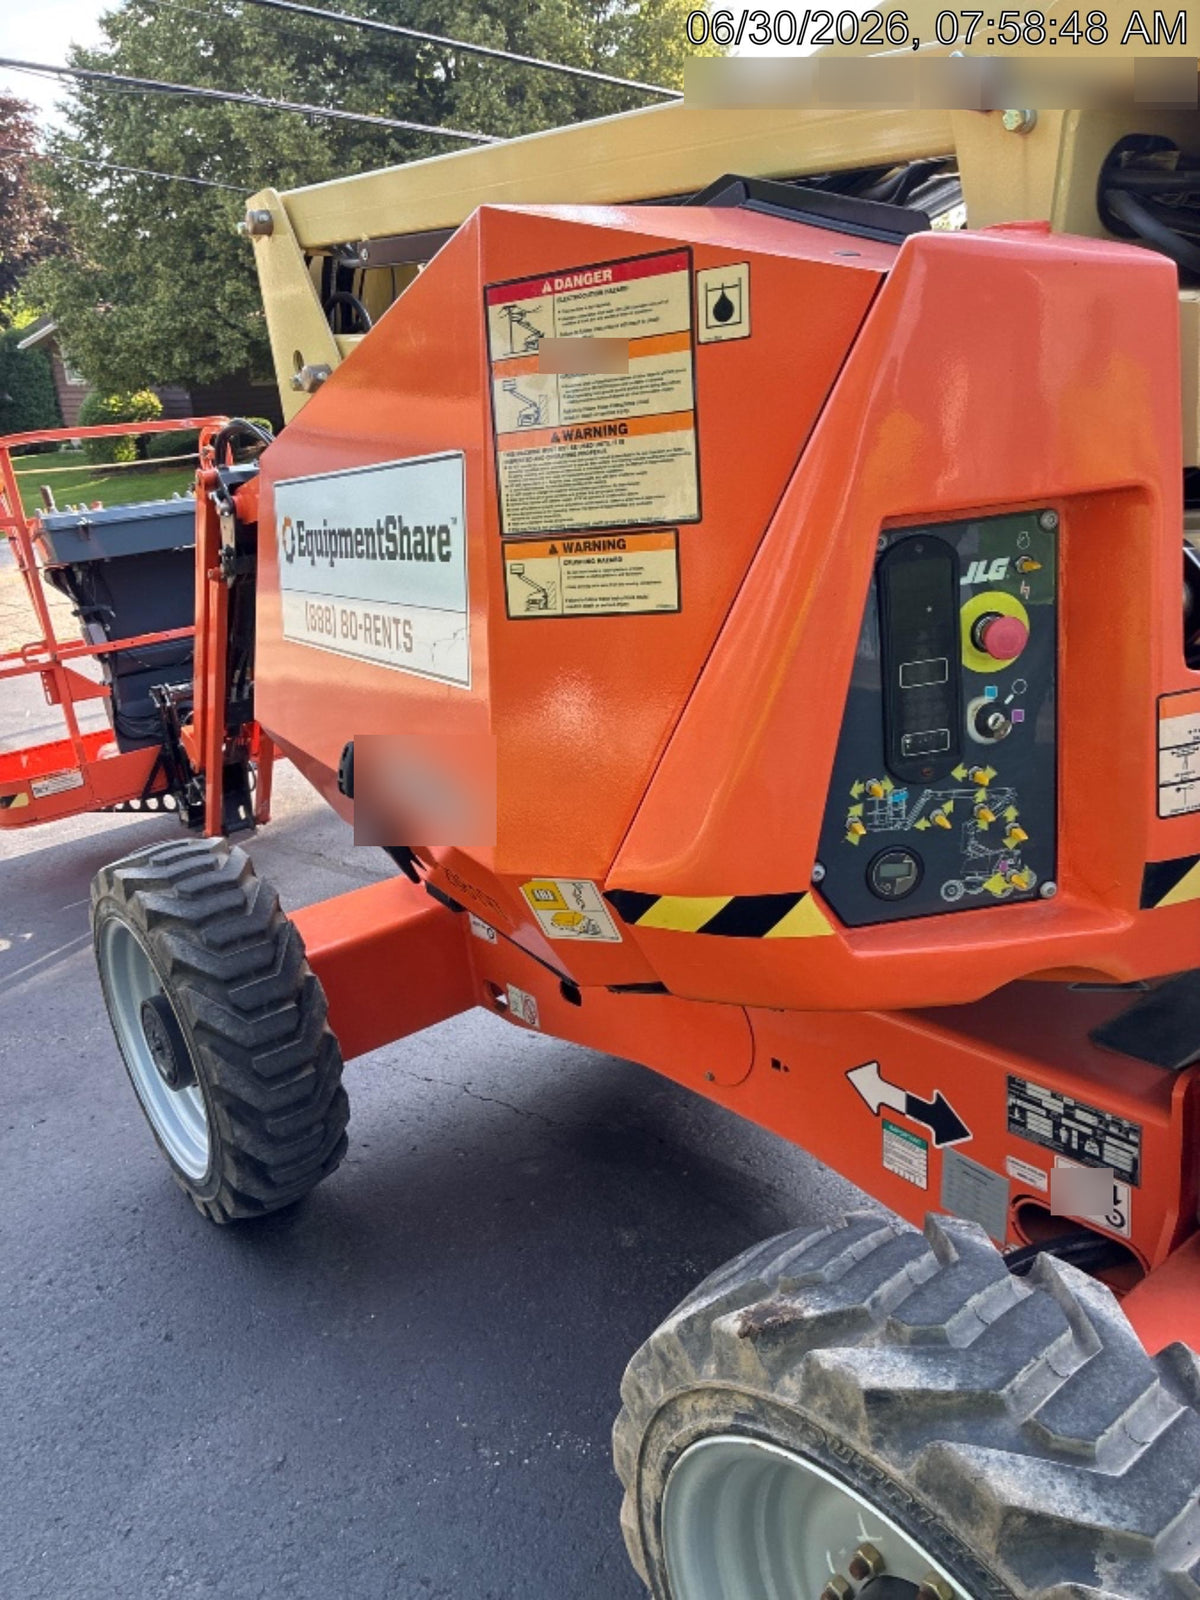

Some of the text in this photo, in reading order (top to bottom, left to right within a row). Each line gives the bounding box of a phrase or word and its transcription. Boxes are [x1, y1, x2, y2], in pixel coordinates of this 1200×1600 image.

[554, 268, 613, 291] DANGER
[562, 423, 629, 442] WARNING
[563, 538, 626, 554] WARNING
[960, 556, 1010, 585] JLG
[305, 600, 413, 653] (888) 80-RENTS
